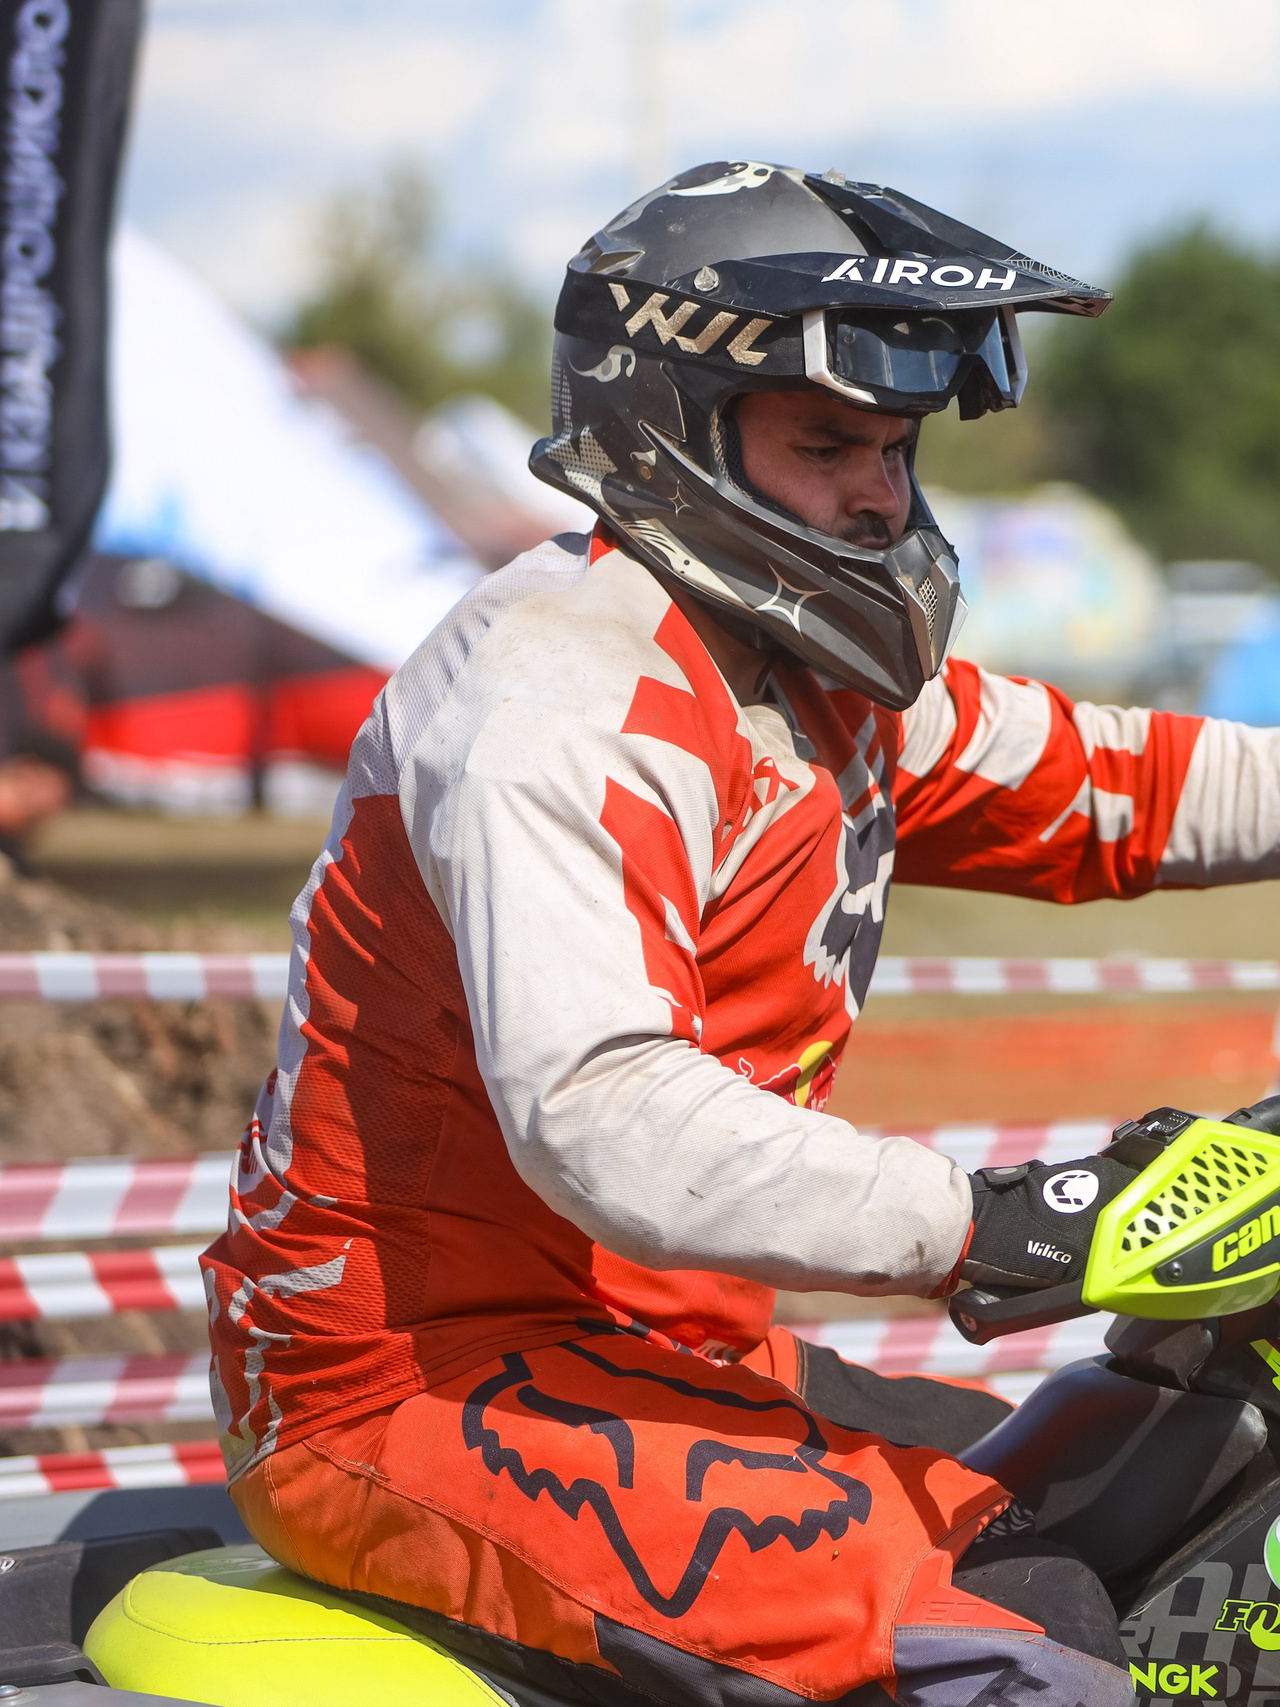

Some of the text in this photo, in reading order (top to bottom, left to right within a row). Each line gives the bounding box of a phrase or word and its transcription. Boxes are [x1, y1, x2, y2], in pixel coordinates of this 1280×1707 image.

[821, 257, 1017, 291] AIROH
[1027, 1240, 1072, 1264] Vilico
[1129, 1661, 1219, 1698] NGK
